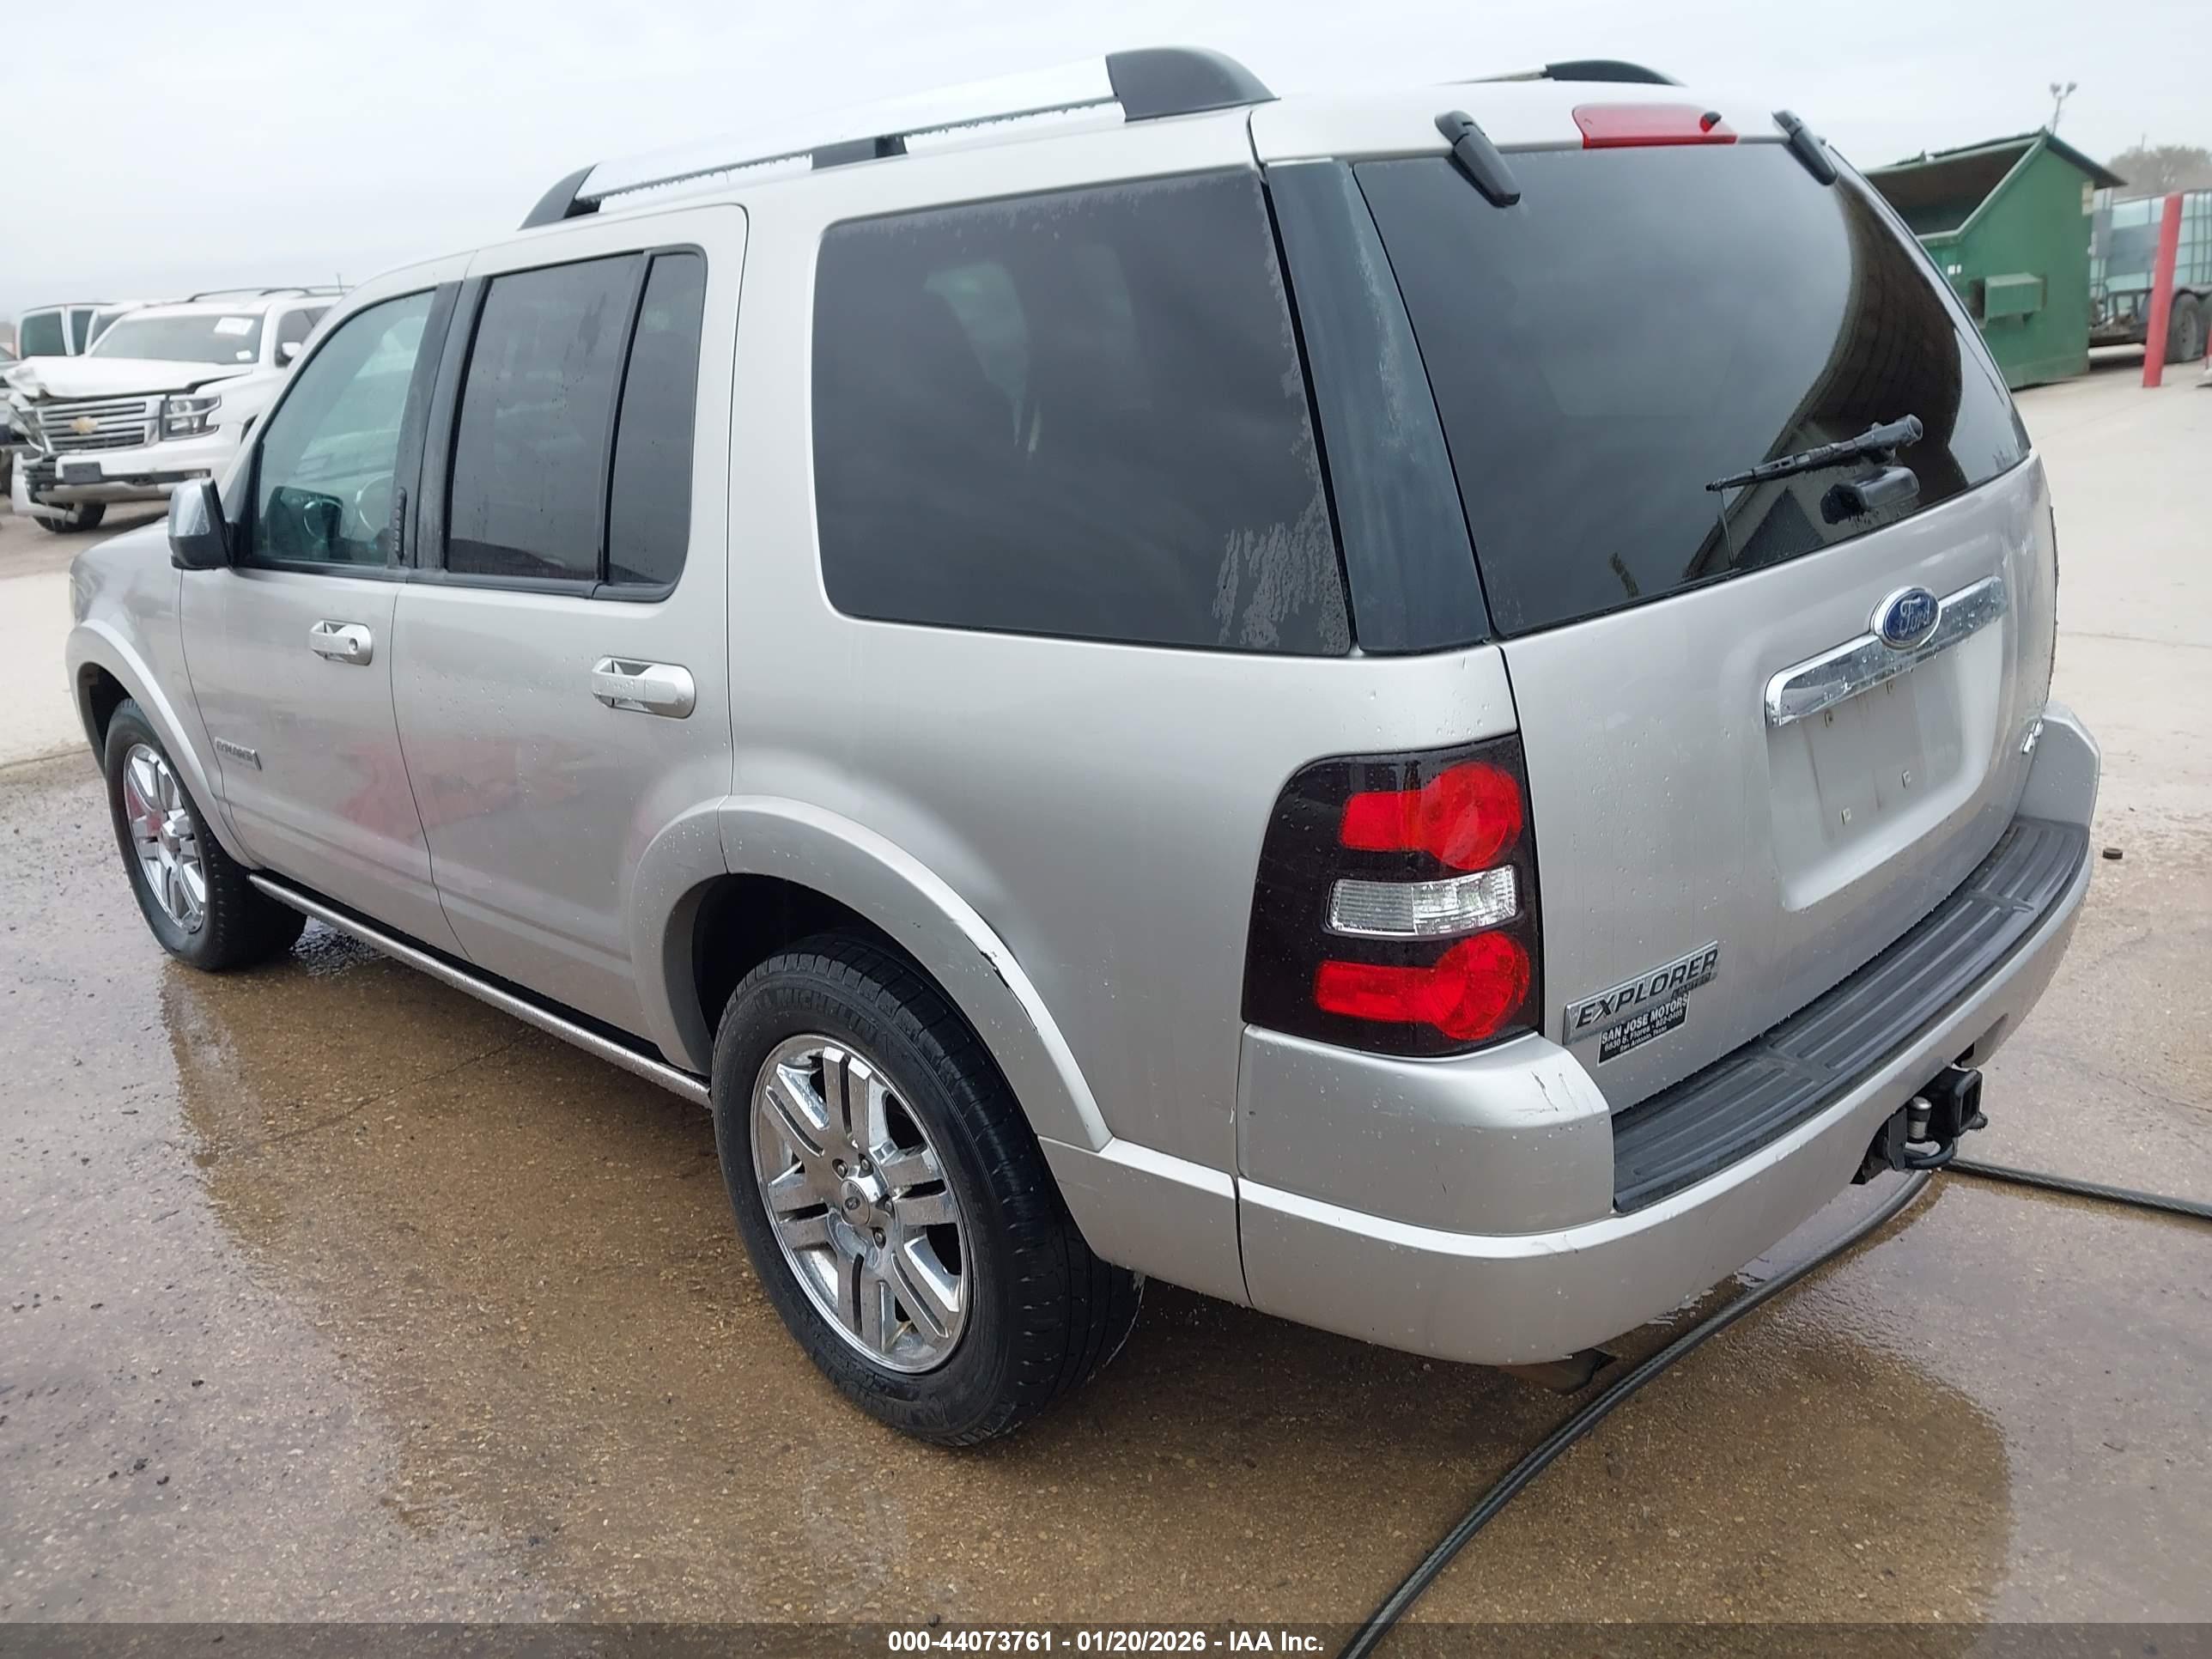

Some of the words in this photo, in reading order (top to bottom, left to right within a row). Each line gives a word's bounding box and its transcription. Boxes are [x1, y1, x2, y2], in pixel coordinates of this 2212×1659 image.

[1898, 596, 1931, 636] Ford
[1575, 947, 1718, 1030] EXPLORER
[1601, 1024, 1622, 1045] SAN
[1624, 1013, 1649, 1035] JOSE
[1650, 993, 1688, 1023] MOTORS
